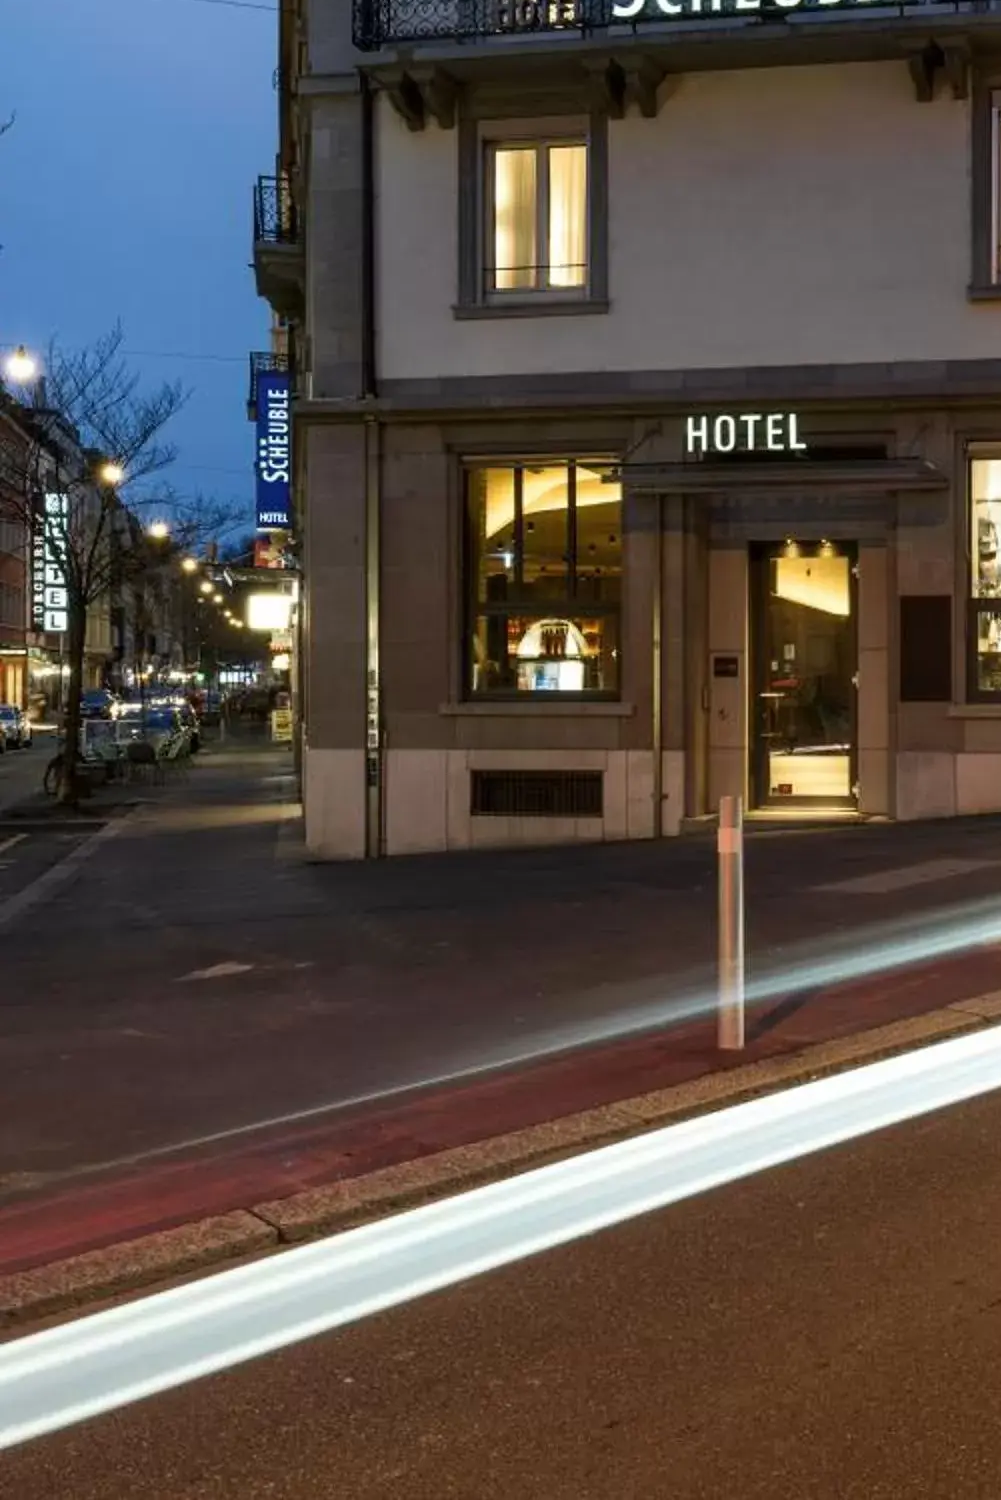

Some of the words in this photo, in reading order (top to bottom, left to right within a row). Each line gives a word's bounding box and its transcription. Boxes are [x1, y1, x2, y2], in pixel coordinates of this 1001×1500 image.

[262, 389, 288, 483] SCHEUBLE
[687, 413, 806, 452] HOTEL
[259, 511, 288, 523] HOTEL
